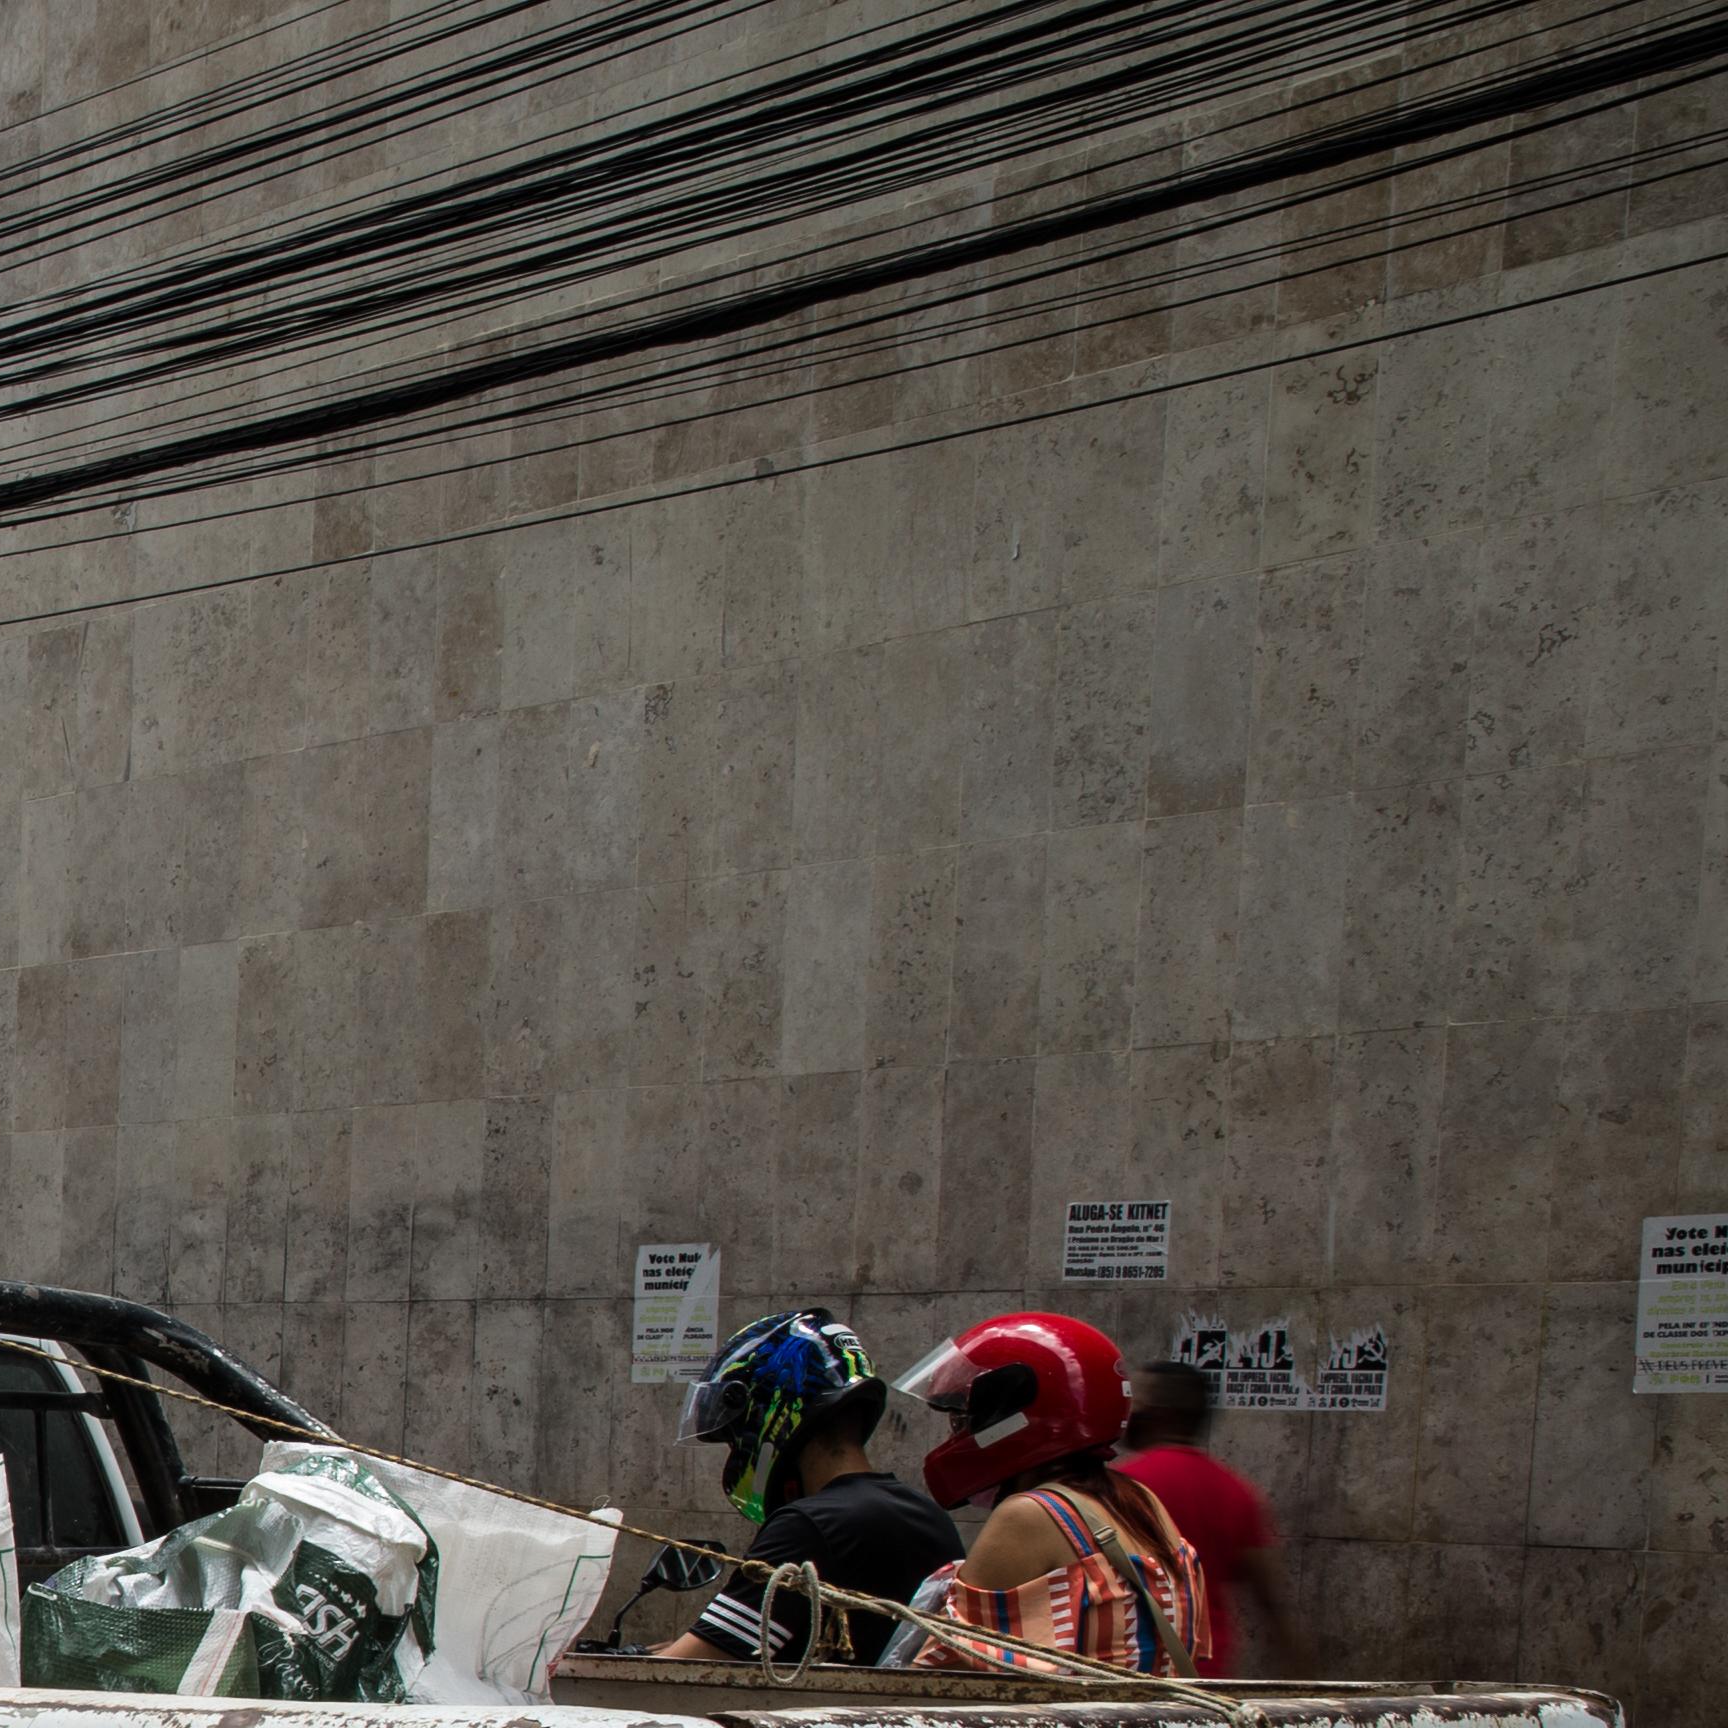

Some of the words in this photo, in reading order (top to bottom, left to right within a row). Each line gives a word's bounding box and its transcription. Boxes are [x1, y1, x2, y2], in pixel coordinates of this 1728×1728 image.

[1069, 1204, 1123, 1221] ALUGA-SE
[1127, 1203, 1169, 1220] KITNET
[1651, 1246, 1685, 1258] nas
[649, 1254, 675, 1264] Vote
[643, 1268, 661, 1277] nas
